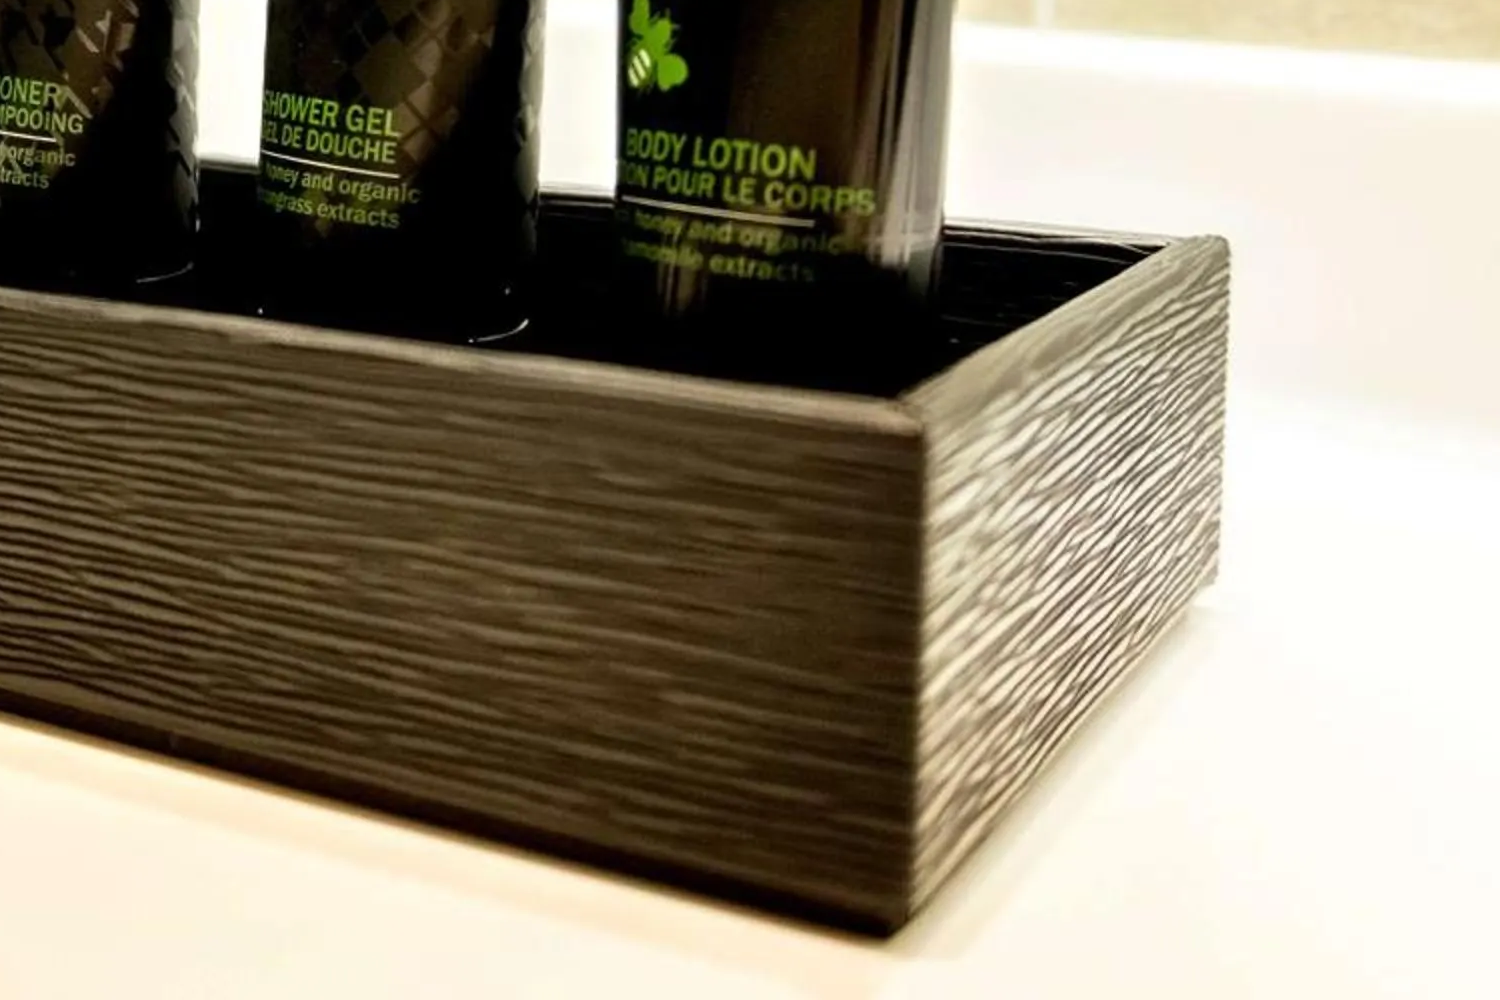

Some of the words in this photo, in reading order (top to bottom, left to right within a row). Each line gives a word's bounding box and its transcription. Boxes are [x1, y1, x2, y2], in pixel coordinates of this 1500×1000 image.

[345, 104, 402, 138] GEL
[9, 144, 77, 168] organic
[281, 123, 304, 149] DE
[306, 128, 399, 165] DOUCHE
[625, 128, 688, 164] BODY
[693, 136, 818, 182] LOTION
[301, 171, 334, 192] and
[339, 178, 423, 205] organic
[652, 165, 717, 199] POUR
[722, 175, 758, 206] LE
[765, 180, 877, 217] CORPS
[317, 202, 402, 230] extracts
[687, 218, 733, 246] and
